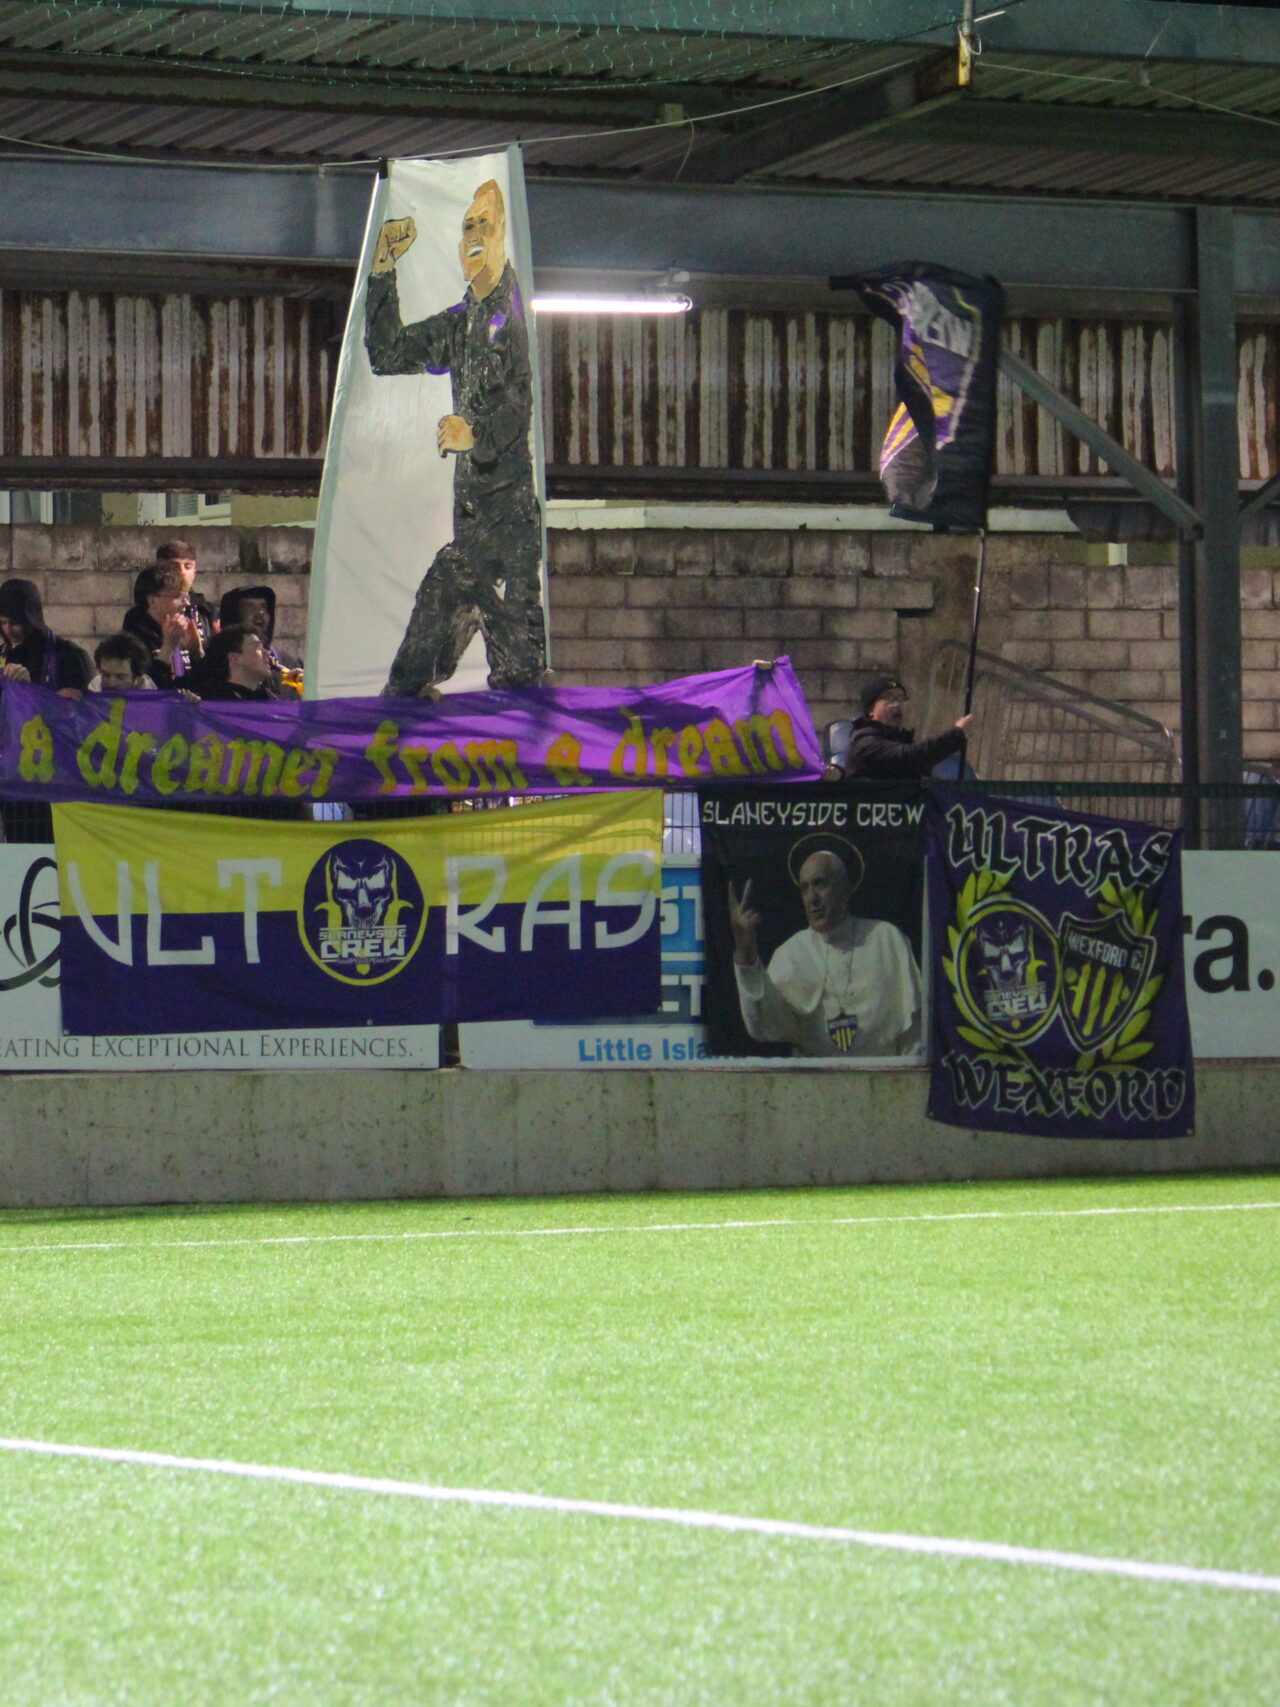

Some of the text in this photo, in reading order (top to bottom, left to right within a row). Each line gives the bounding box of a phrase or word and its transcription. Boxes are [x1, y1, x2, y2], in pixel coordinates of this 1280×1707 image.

[76, 698, 339, 797] dreamer
[365, 719, 529, 796] from
[544, 731, 593, 787] a
[609, 705, 804, 784] dream
[702, 800, 925, 827] SLANEYSIDE CREW
[945, 803, 1173, 897] ULTRAS
[321, 938, 405, 959] CREW
[1068, 931, 1128, 968] WEXFORD
[91, 1035, 250, 1059] EXCEPTIONAL
[260, 1033, 414, 1058] EXPERIENCES.
[578, 1037, 652, 1061] Little
[942, 1049, 1186, 1121] WEXFORD
